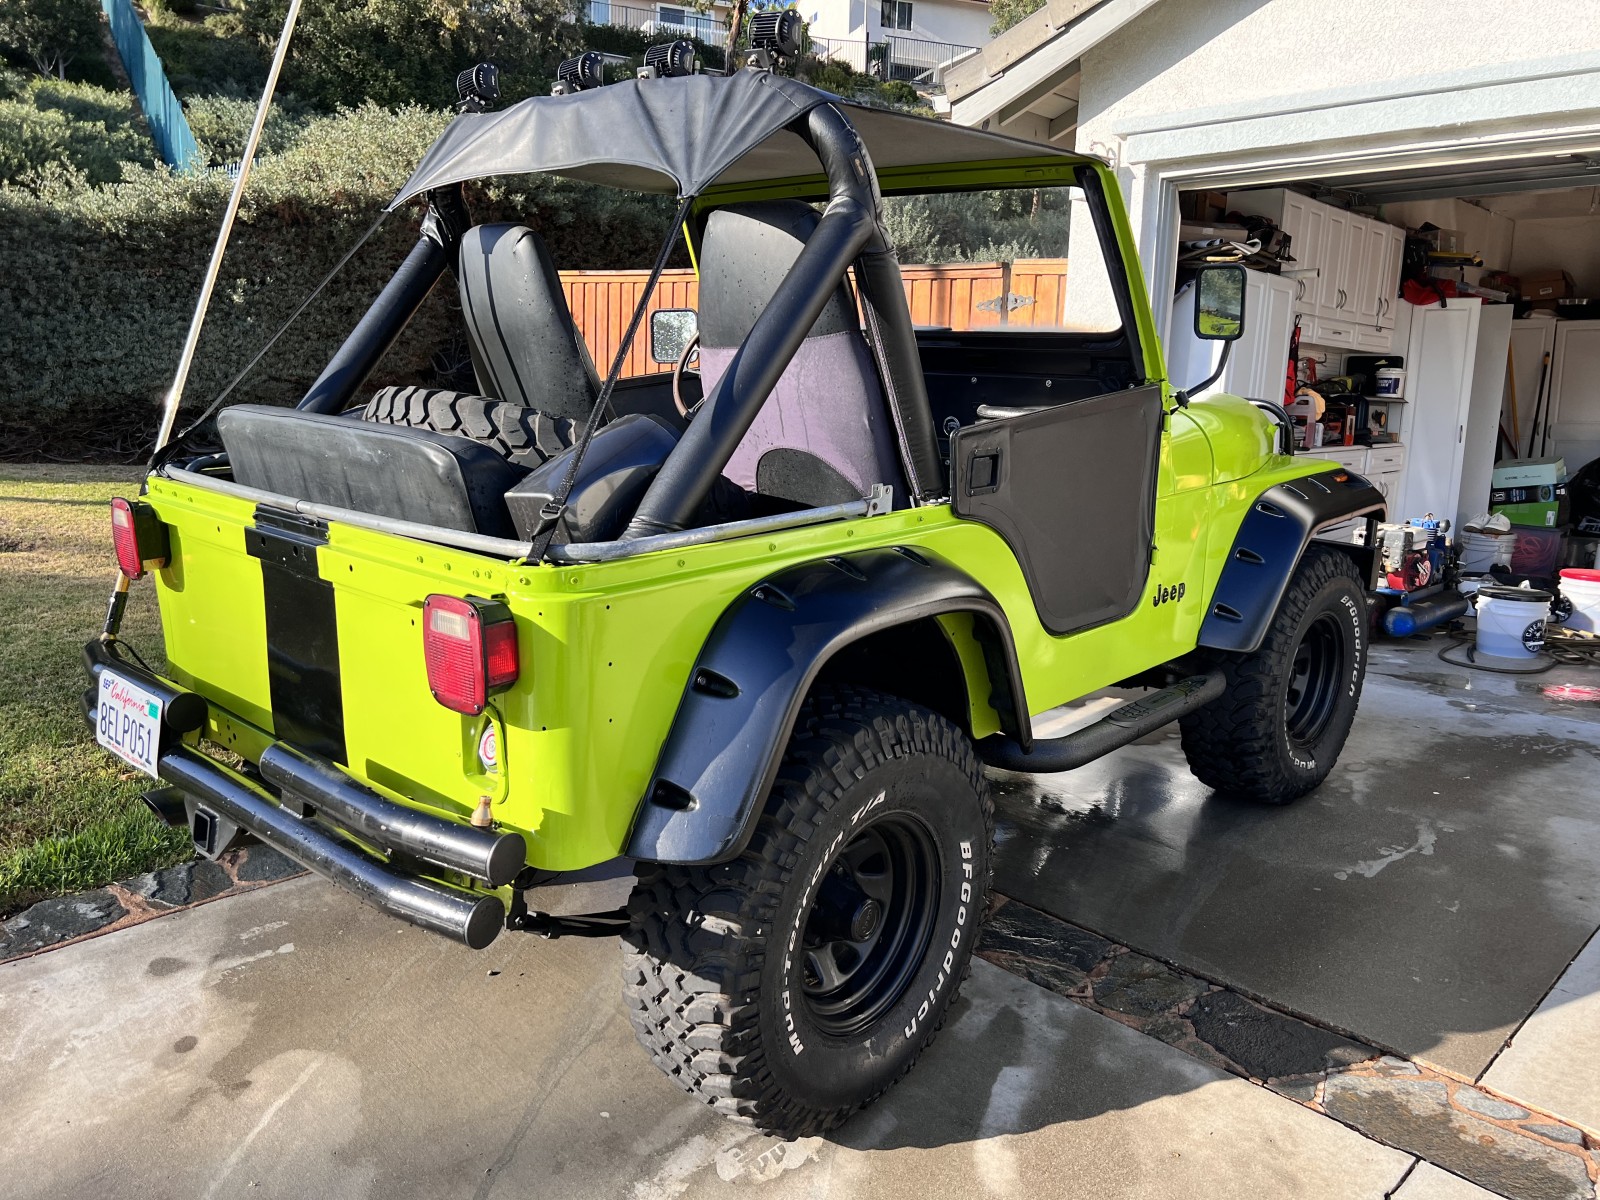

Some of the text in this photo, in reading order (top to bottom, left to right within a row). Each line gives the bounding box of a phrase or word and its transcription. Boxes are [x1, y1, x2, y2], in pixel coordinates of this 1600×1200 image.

[1153, 583, 1185, 607] Jeep
[111, 682, 149, 717] California
[100, 701, 152, 766] 8ELP051
